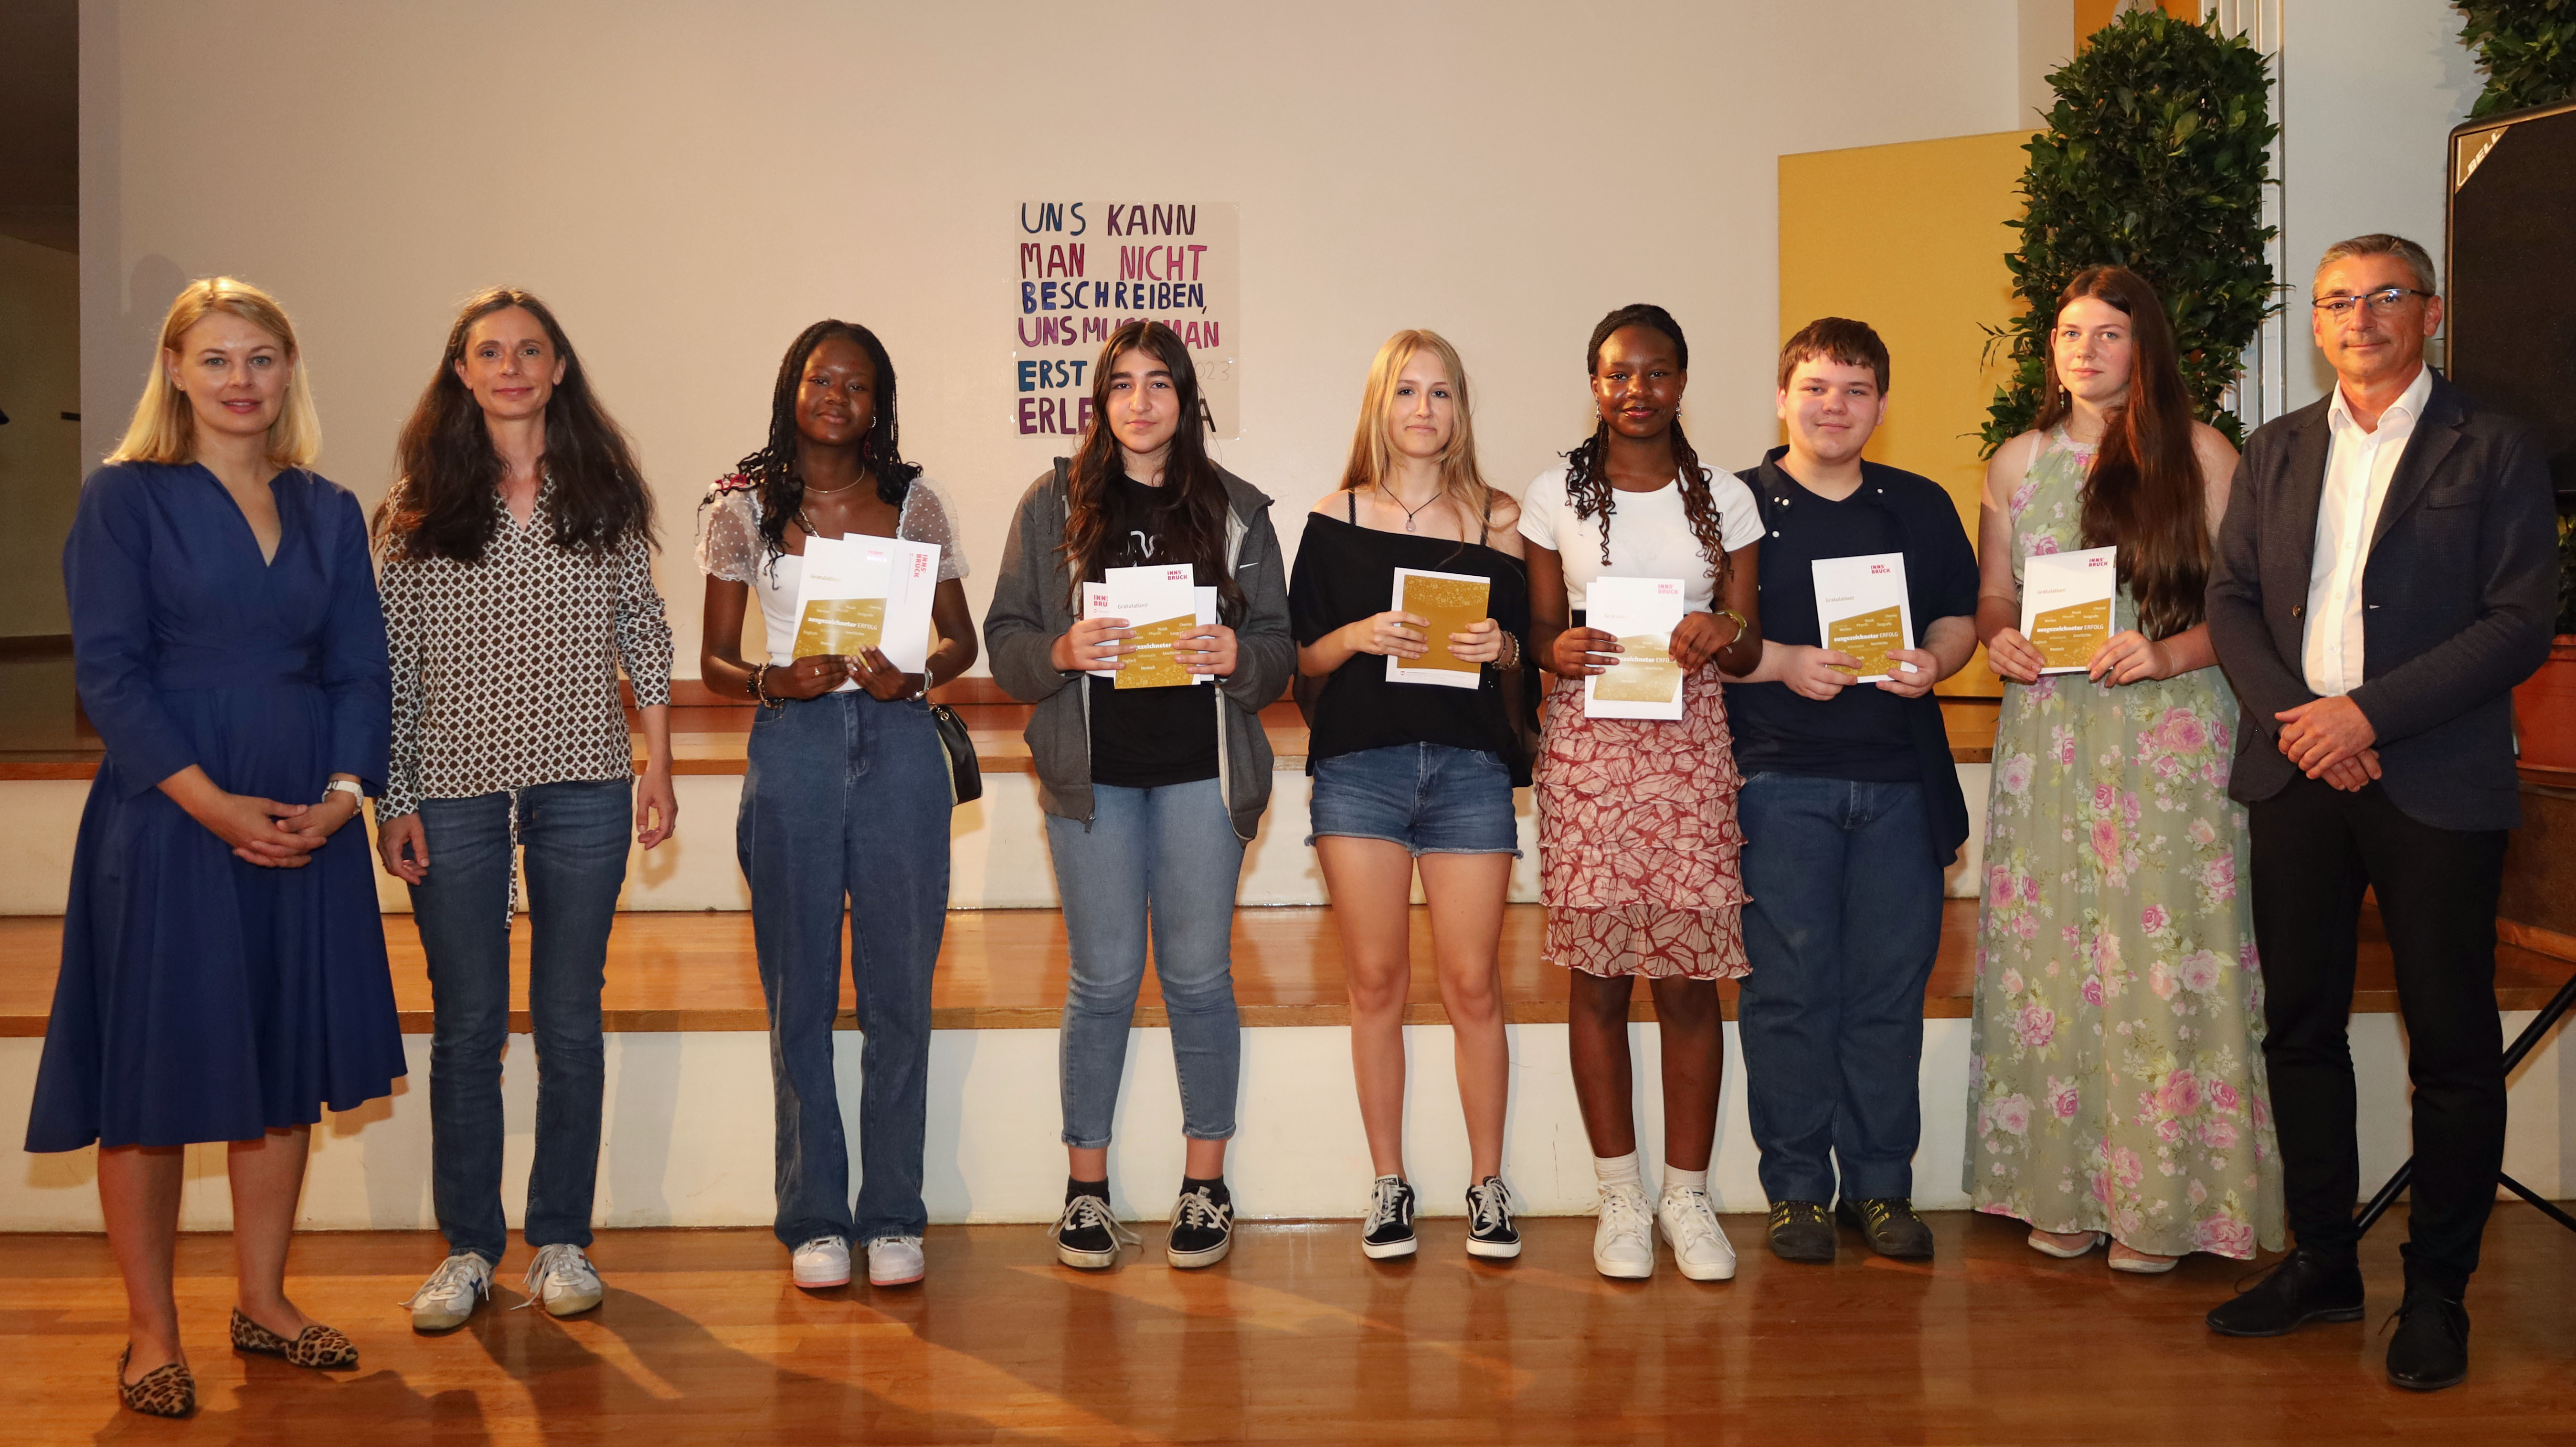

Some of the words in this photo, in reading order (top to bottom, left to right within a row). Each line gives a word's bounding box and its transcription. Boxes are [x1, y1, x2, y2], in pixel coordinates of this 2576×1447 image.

[2467, 133, 2501, 174] BELL
[1021, 202, 1086, 236] UNS
[1107, 204, 1196, 236] KANN
[1021, 243, 1084, 278] MAN
[1120, 245, 1208, 280] NICHT
[1021, 281, 1207, 314] BESCHREIBEN,
[1018, 316, 1077, 347] UNS
[1018, 359, 1087, 392] ERST
[1195, 361, 1230, 380] 023
[1018, 397, 1094, 435] ERLE
[1834, 634, 1879, 642] ausgezeichneter
